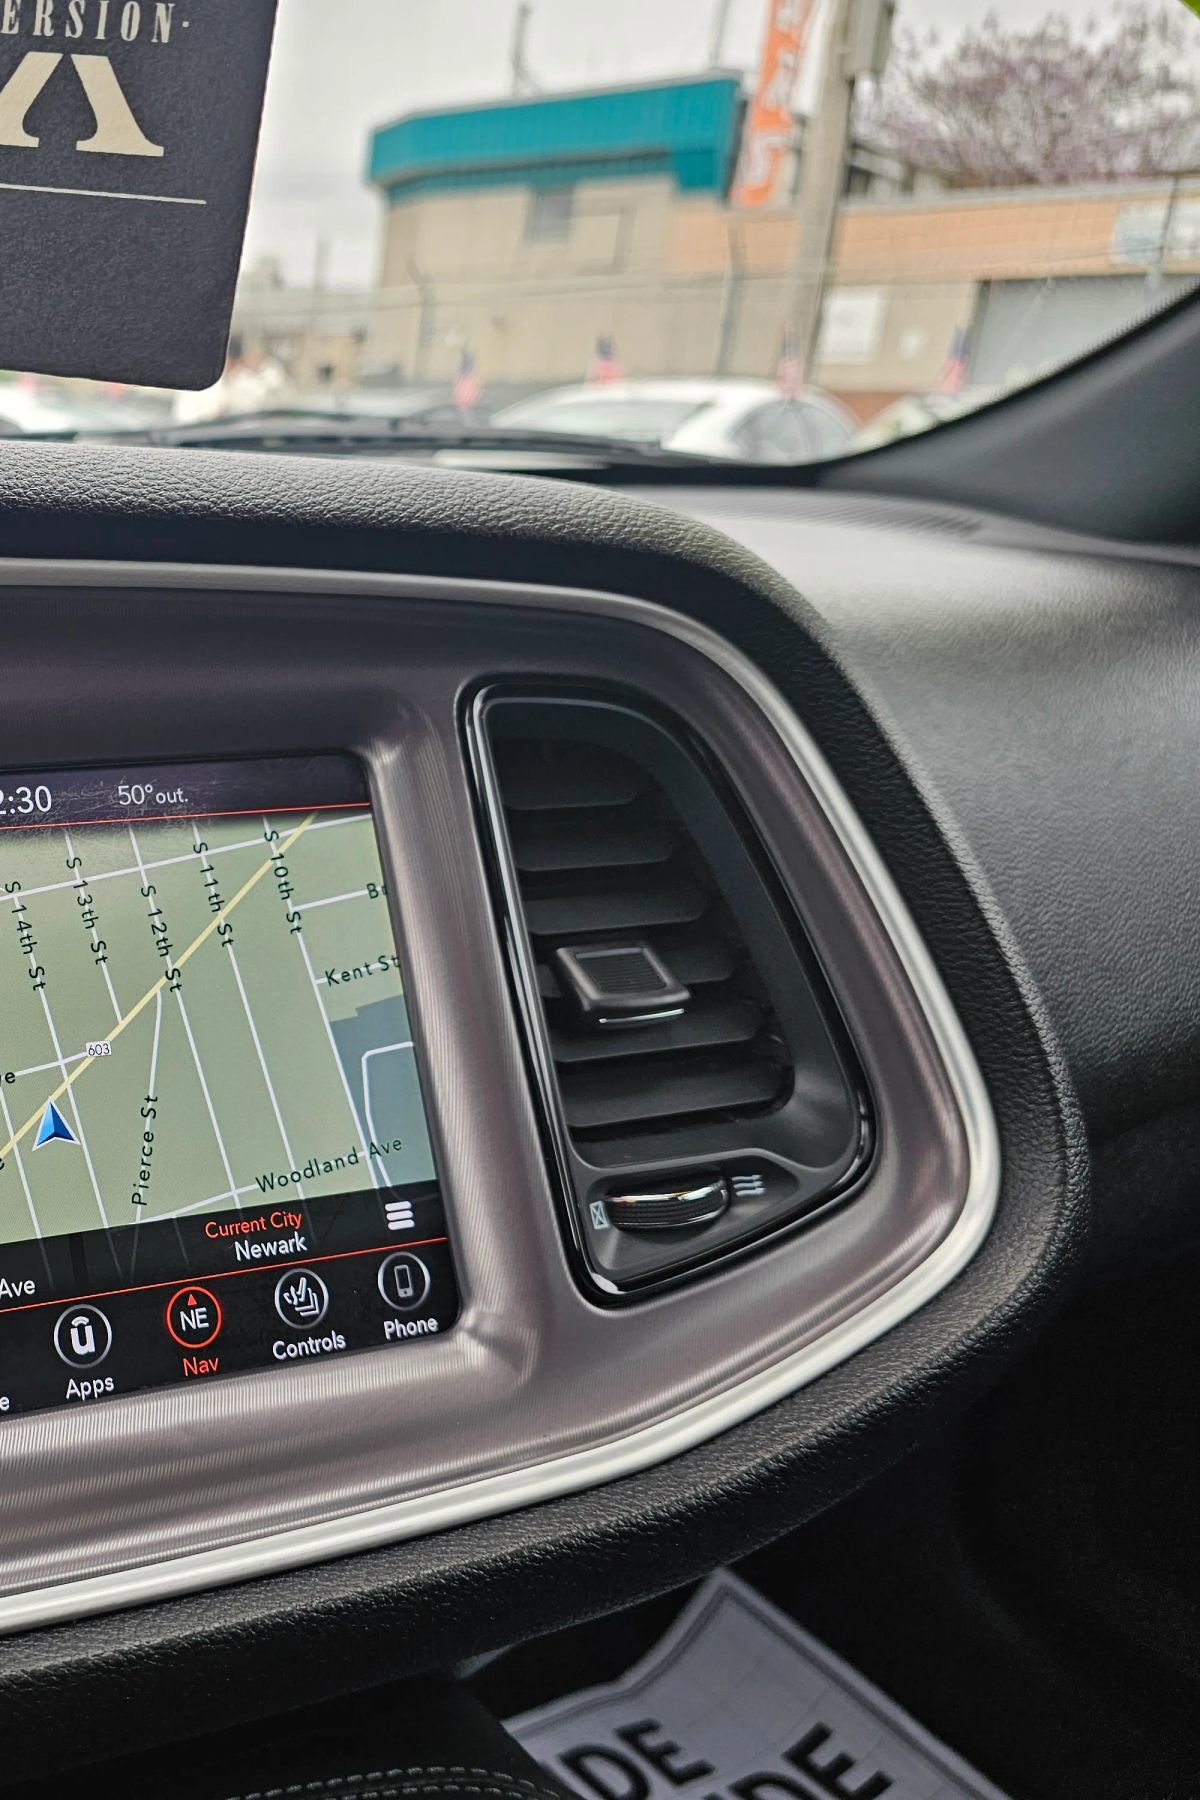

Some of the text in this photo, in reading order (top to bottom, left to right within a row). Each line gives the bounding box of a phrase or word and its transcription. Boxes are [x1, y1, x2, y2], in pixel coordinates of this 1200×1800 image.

[193, 841, 234, 948] S 11th St
[263, 830, 303, 935] S 10th St
[66, 857, 108, 965] S 13th St
[4, 880, 47, 991] S 14th St
[140, 884, 183, 993] S 12th St
[325, 954, 400, 987] Kent St
[87, 1041, 112, 1057] 603
[132, 1095, 158, 1206] Pierce St
[255, 1137, 403, 1193] Woodland Ave
[205, 1210, 303, 1240] Current City
[234, 1231, 308, 1263] Newark
[179, 1307, 210, 1331] NE
[383, 1314, 439, 1341] Phone
[272, 1329, 347, 1361] Controls
[182, 1355, 220, 1377] Nav
[65, 1374, 116, 1401] Apps
